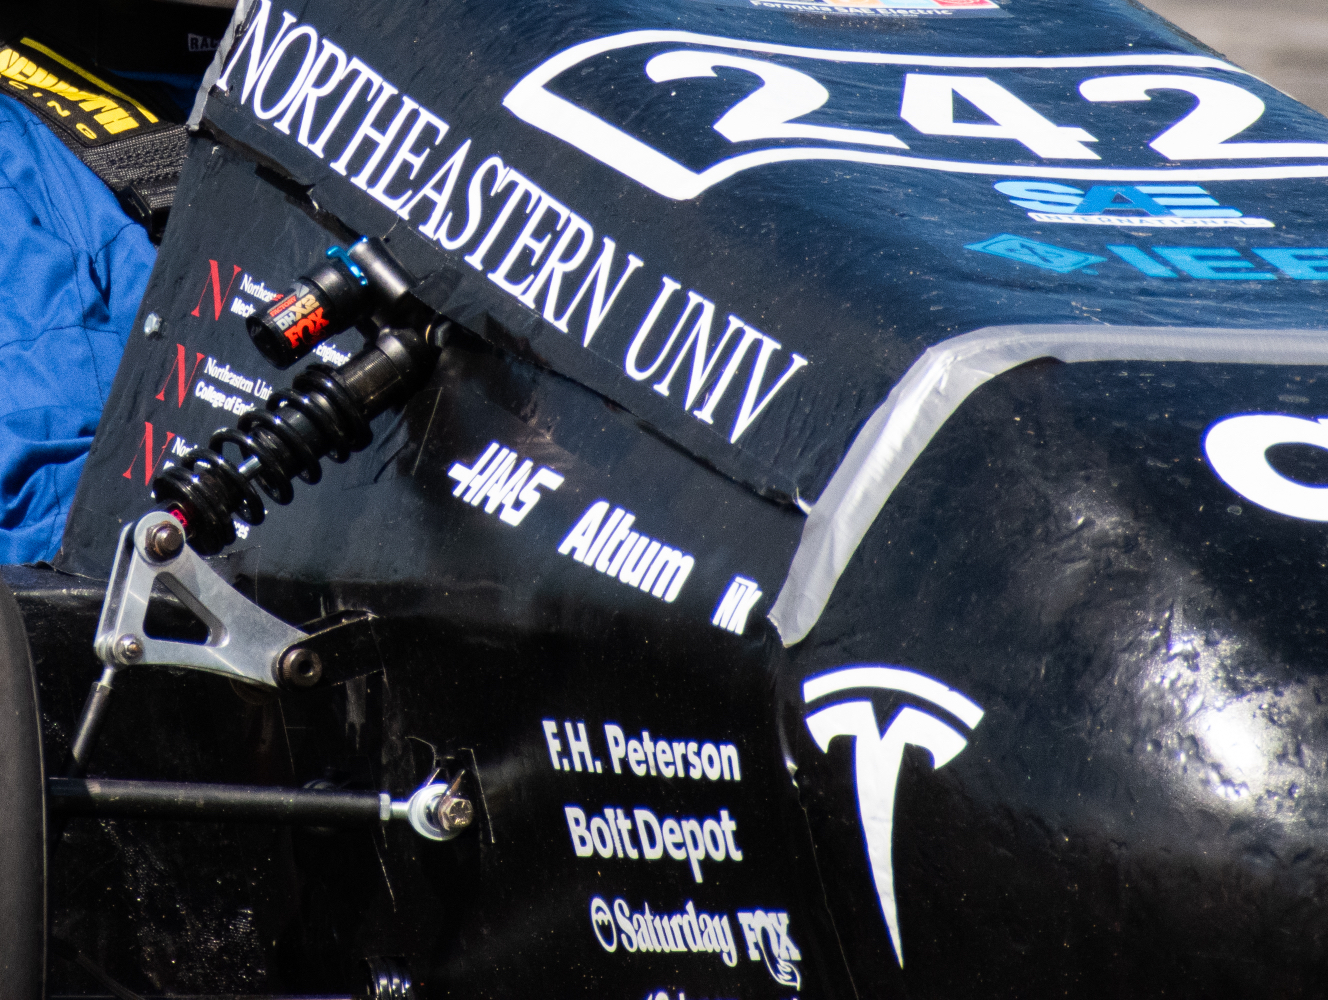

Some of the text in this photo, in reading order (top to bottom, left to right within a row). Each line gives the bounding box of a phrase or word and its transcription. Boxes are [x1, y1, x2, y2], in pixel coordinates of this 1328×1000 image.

[645, 50, 1328, 160] 242
[993, 180, 1243, 217] SAE
[283, 306, 330, 349] FOX
[624, 276, 810, 444] UNIV
[195, 380, 226, 408] College
[223, 395, 238, 412] of
[203, 356, 254, 394] Northeastern
[558, 501, 695, 603] Altium
[542, 719, 742, 782] F.H. Peterson
[565, 805, 744, 884] Bolt Depot
[613, 898, 802, 976] Saturday FOX
